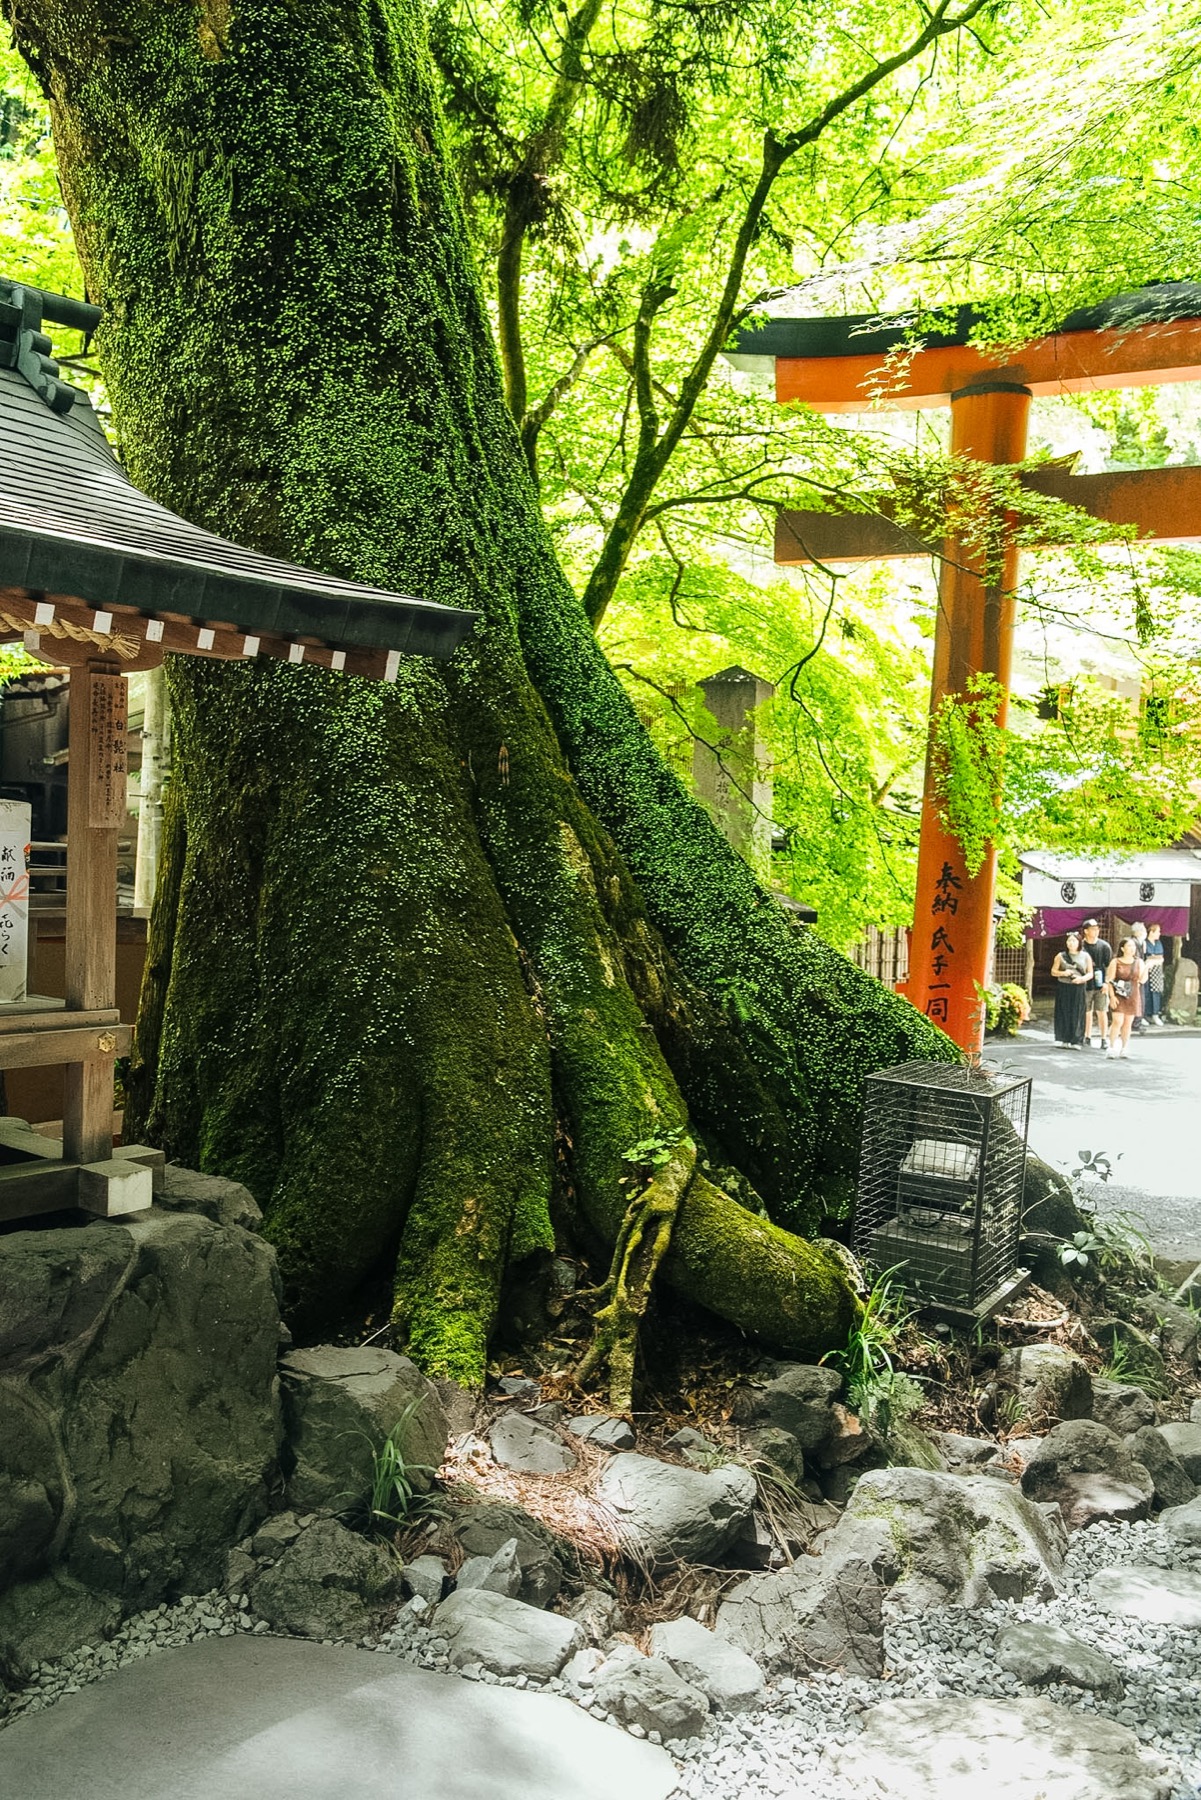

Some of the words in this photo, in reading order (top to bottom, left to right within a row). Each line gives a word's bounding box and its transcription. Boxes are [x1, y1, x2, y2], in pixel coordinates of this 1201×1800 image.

[931, 861, 963, 916] 奉納
[925, 926, 955, 1023] 氏子一同
